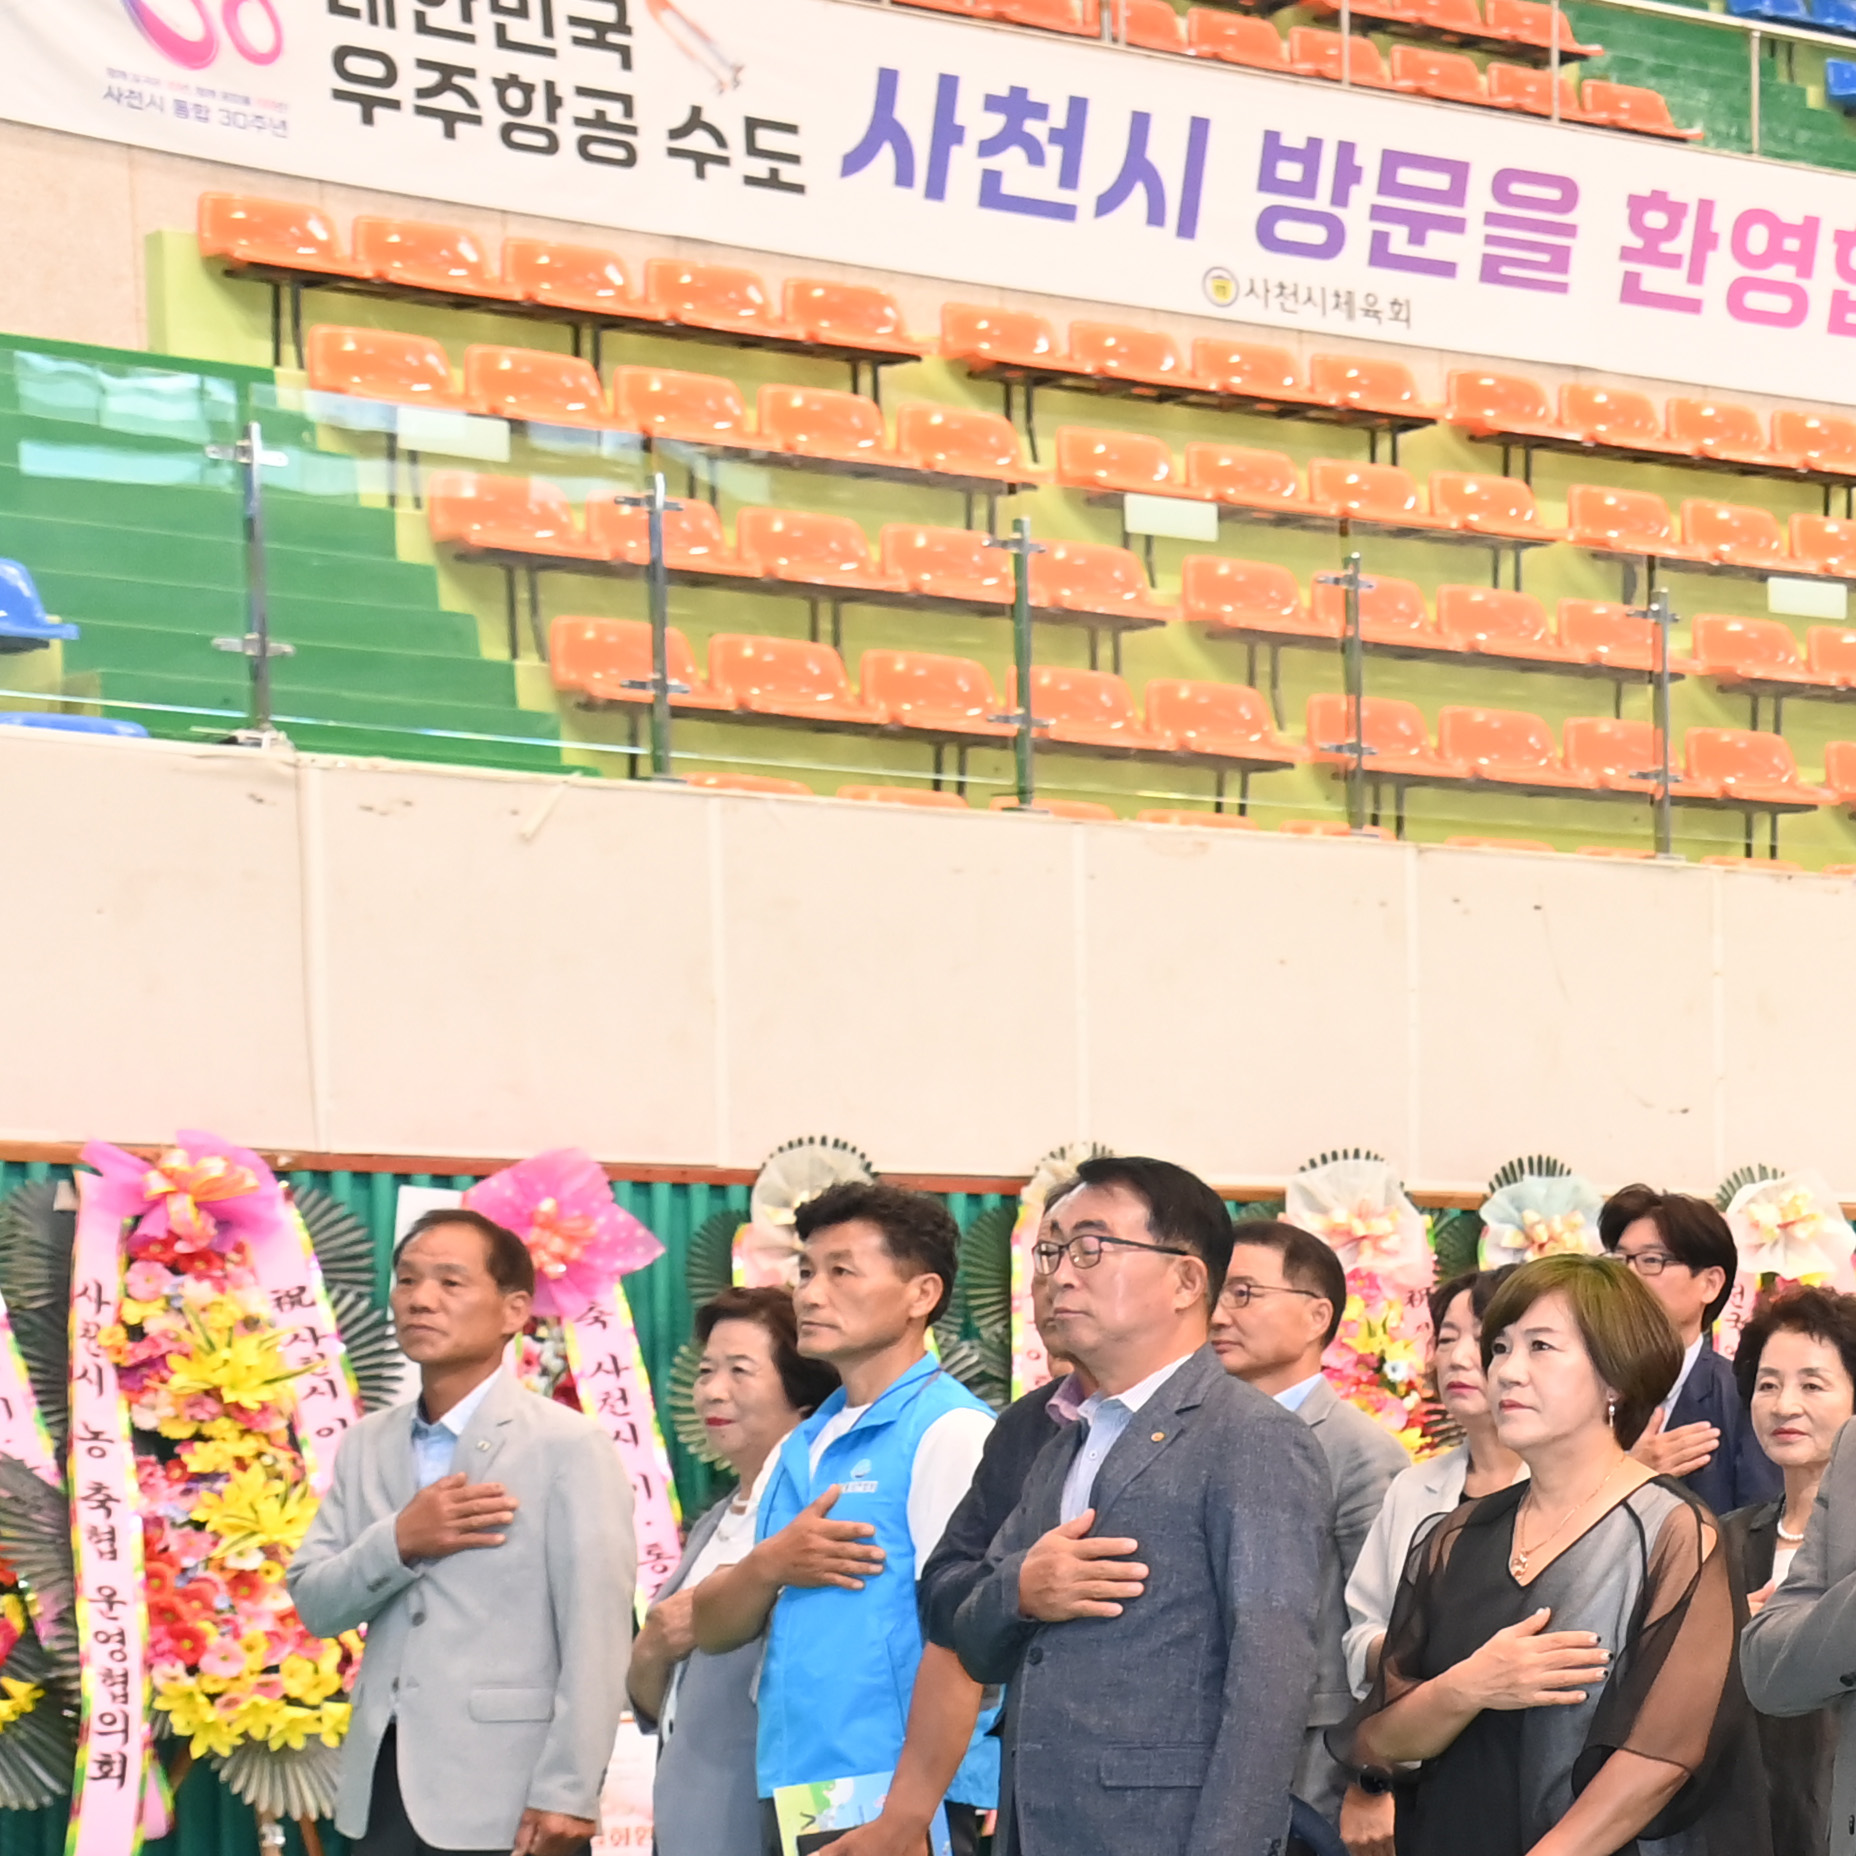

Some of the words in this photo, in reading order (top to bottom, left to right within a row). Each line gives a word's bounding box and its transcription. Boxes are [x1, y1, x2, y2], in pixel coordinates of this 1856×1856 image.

[102, 84, 166, 113] 사천시
[217, 107, 289, 139] 30주년
[331, 44, 638, 169] 우주항공
[666, 104, 806, 195] 수도
[840, 66, 1211, 240] 사천시
[1254, 129, 1581, 295] 방문을
[1243, 275, 1413, 330] 사천시체육회
[86, 1584, 130, 1791] 운영협의회
